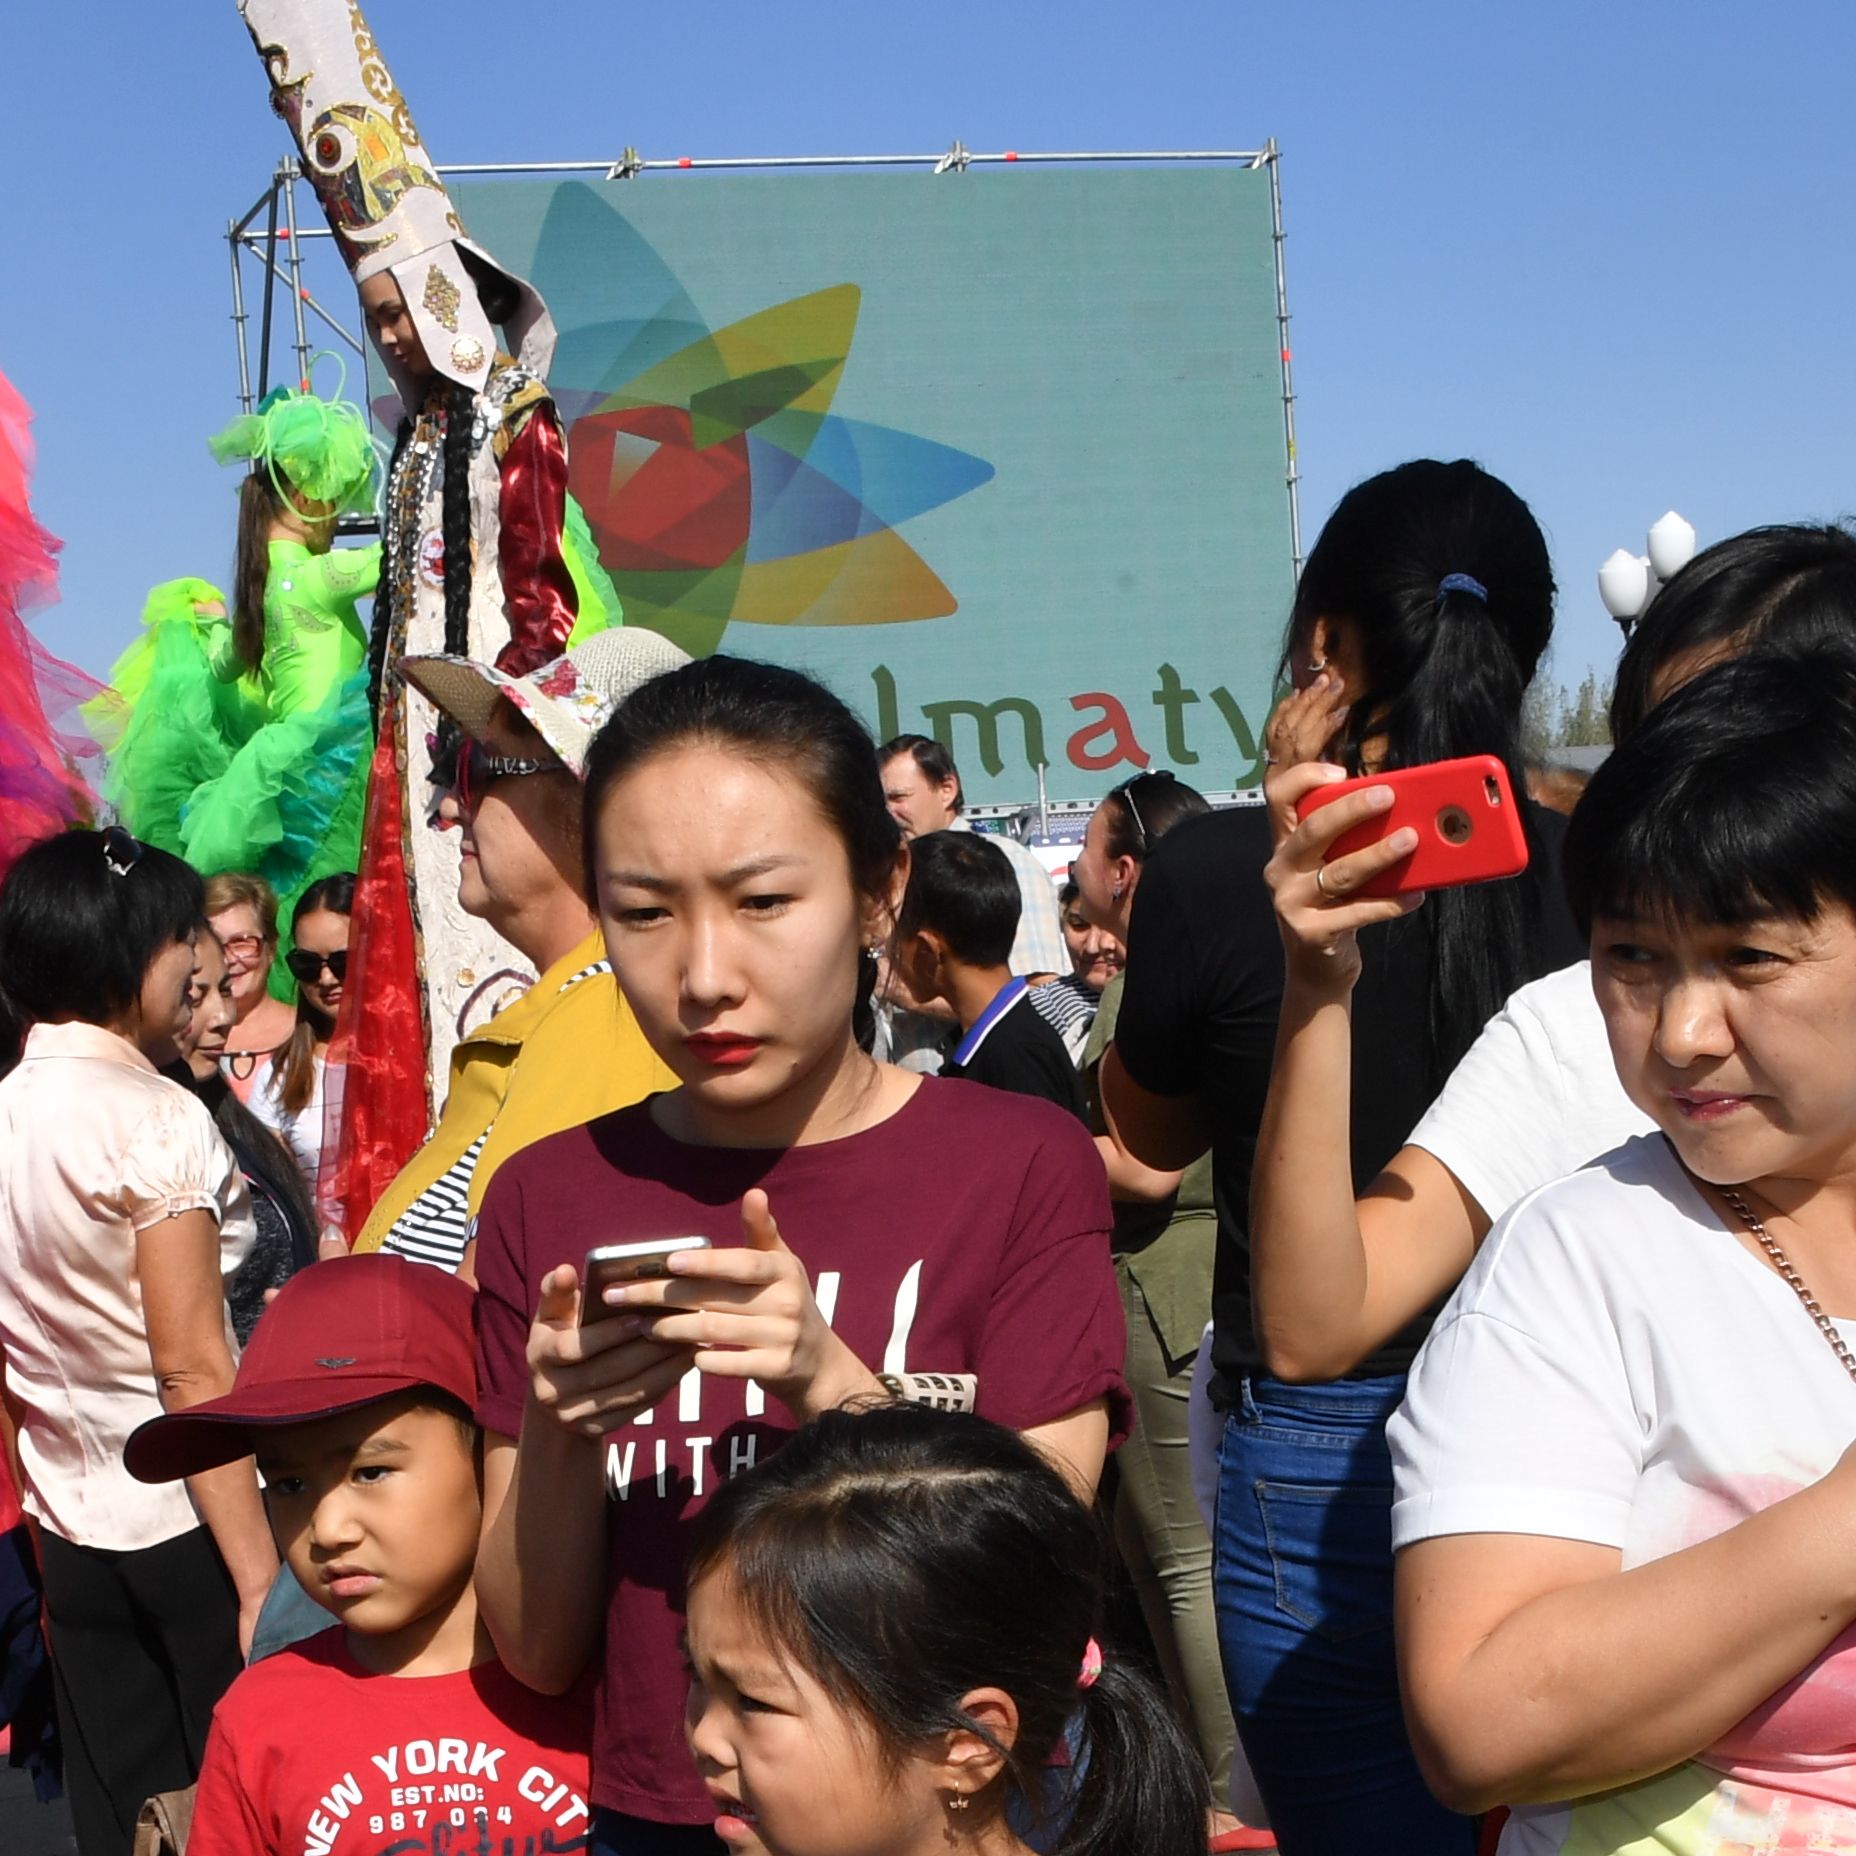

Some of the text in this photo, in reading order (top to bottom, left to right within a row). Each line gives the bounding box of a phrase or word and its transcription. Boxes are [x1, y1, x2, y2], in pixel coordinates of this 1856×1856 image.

[871, 663, 1292, 790] lmaty
[606, 1433, 757, 1501] WITH
[371, 1738, 506, 1783] YORK
[518, 1766, 592, 1835] CIT
